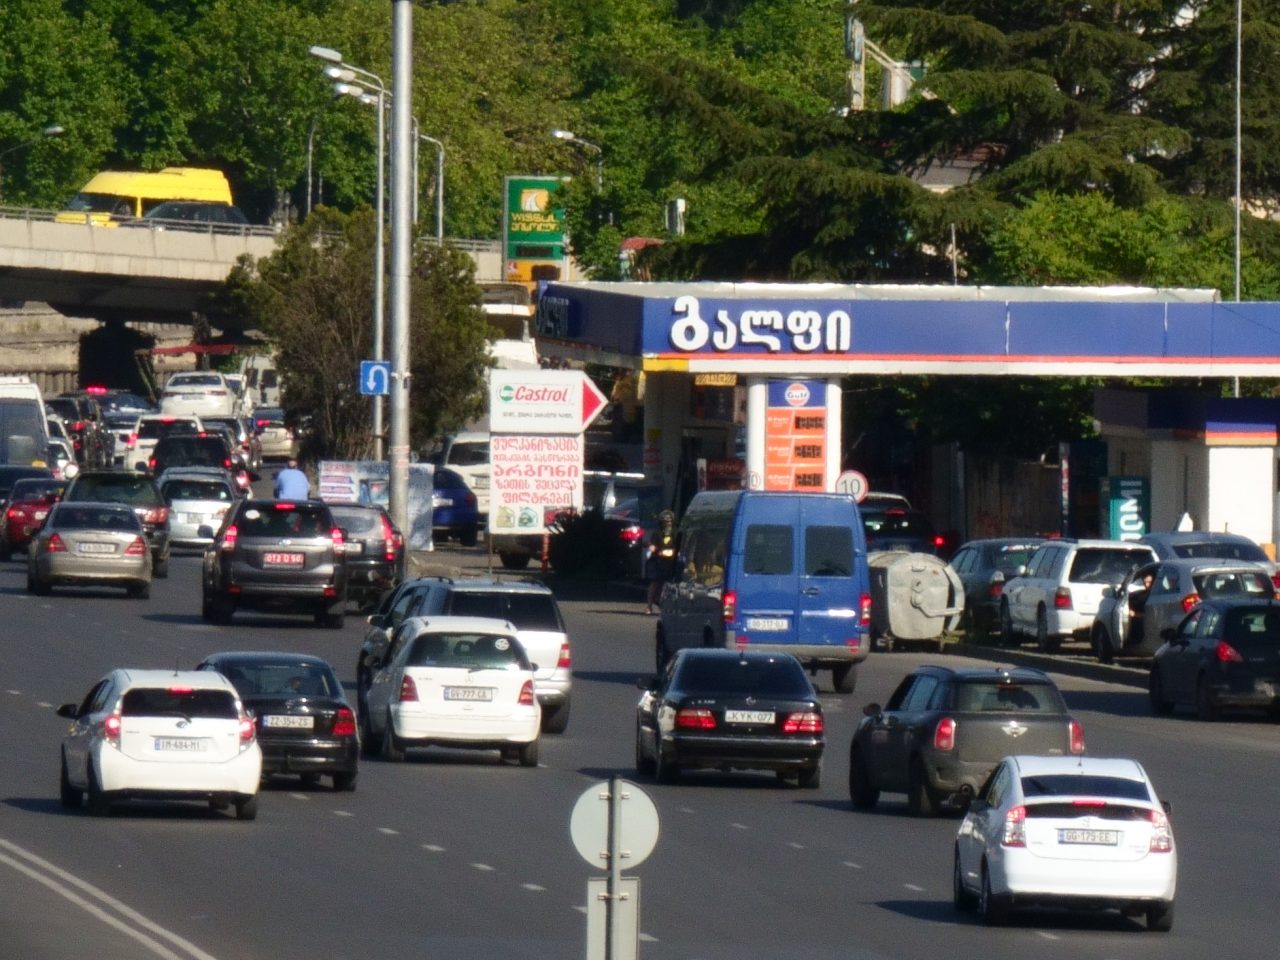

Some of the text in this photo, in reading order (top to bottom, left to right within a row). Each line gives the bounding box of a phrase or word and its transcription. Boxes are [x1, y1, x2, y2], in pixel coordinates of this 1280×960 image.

[671, 295, 851, 351] გალფი
[515, 385, 568, 402] Castrol
[787, 391, 808, 399] Gulf
[493, 438, 579, 451] ვულკანიზაცია
[493, 464, 579, 477] არგონი
[495, 479, 577, 491] ზეთის შეცვლა
[841, 479, 860, 494] 10
[502, 492, 570, 504] ფილტრები
